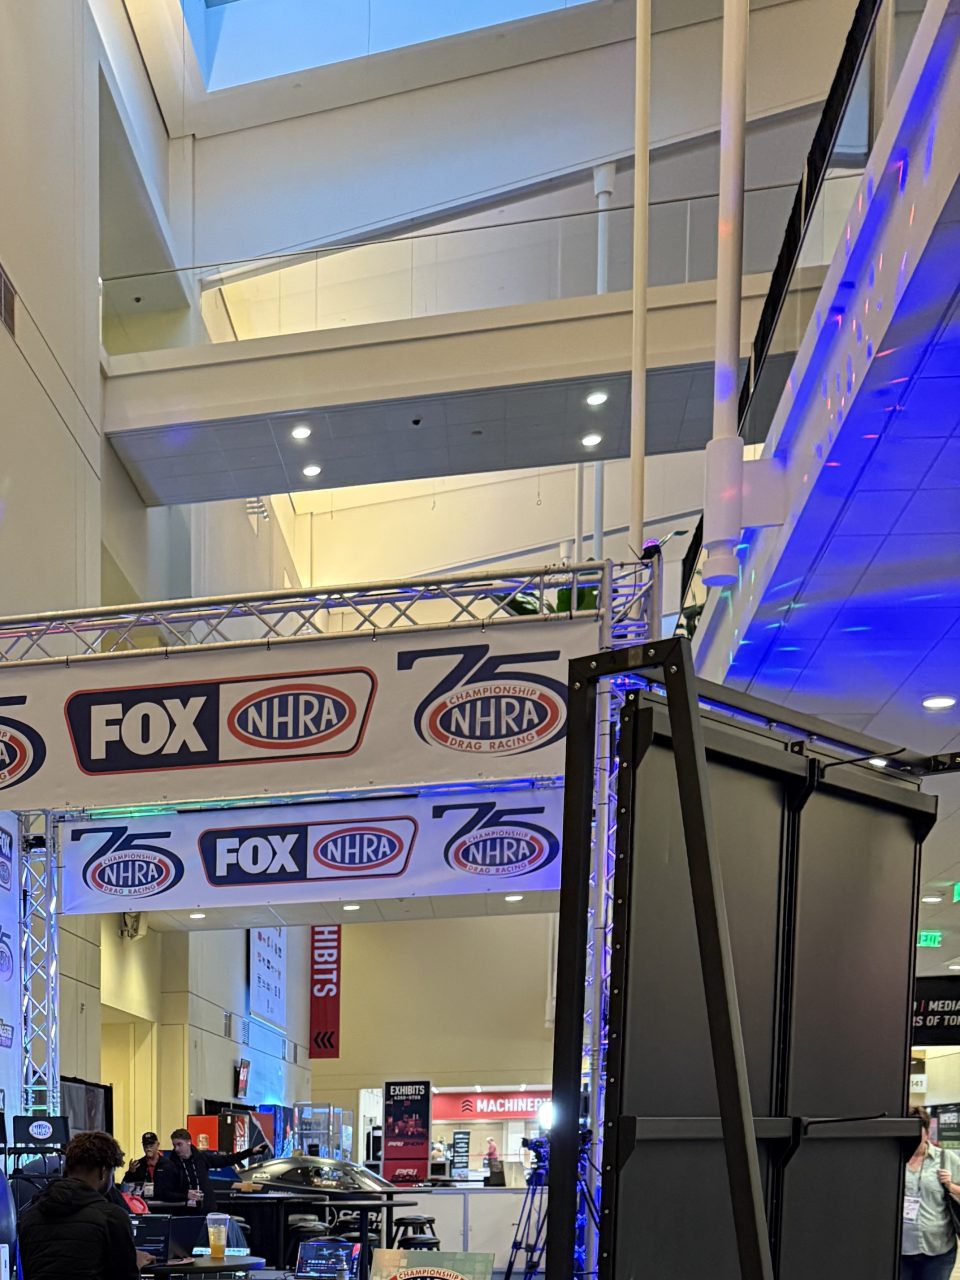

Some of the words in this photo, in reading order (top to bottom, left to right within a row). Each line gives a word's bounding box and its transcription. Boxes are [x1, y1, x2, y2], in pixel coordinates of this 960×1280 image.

[397, 644, 568, 758] 75
[449, 686, 537, 705] CHAMPIONSHIP
[450, 698, 539, 737] NHRA
[90, 696, 208, 760] FOX
[247, 695, 338, 738] NHRA
[449, 737, 482, 751] DRAG
[489, 733, 535, 751] RACING
[432, 802, 560, 879] 75
[468, 831, 529, 843] CHAMPIONSHIP
[103, 853, 158, 865] CHAMPIONSHIP
[216, 834, 299, 877] FOX
[327, 834, 391, 864] NHRA
[469, 838, 530, 865] NHRA
[71, 826, 184, 899] 75
[468, 865, 490, 874] DRAG
[495, 863, 527, 874] RACING
[104, 861, 158, 886] NHRA
[104, 885, 124, 895] DRAG
[128, 884, 156, 895] RACING
[313, 926, 339, 997] HIBITS
[928, 1000, 960, 1012] MEDIA
[926, 1015, 941, 1026] OF
[943, 1015, 960, 1026] TO
[390, 1085, 425, 1096] EXHIBITS
[476, 1098, 551, 1113] MACHINER
[398, 1269, 460, 1280] CHAMPIONSHIP
